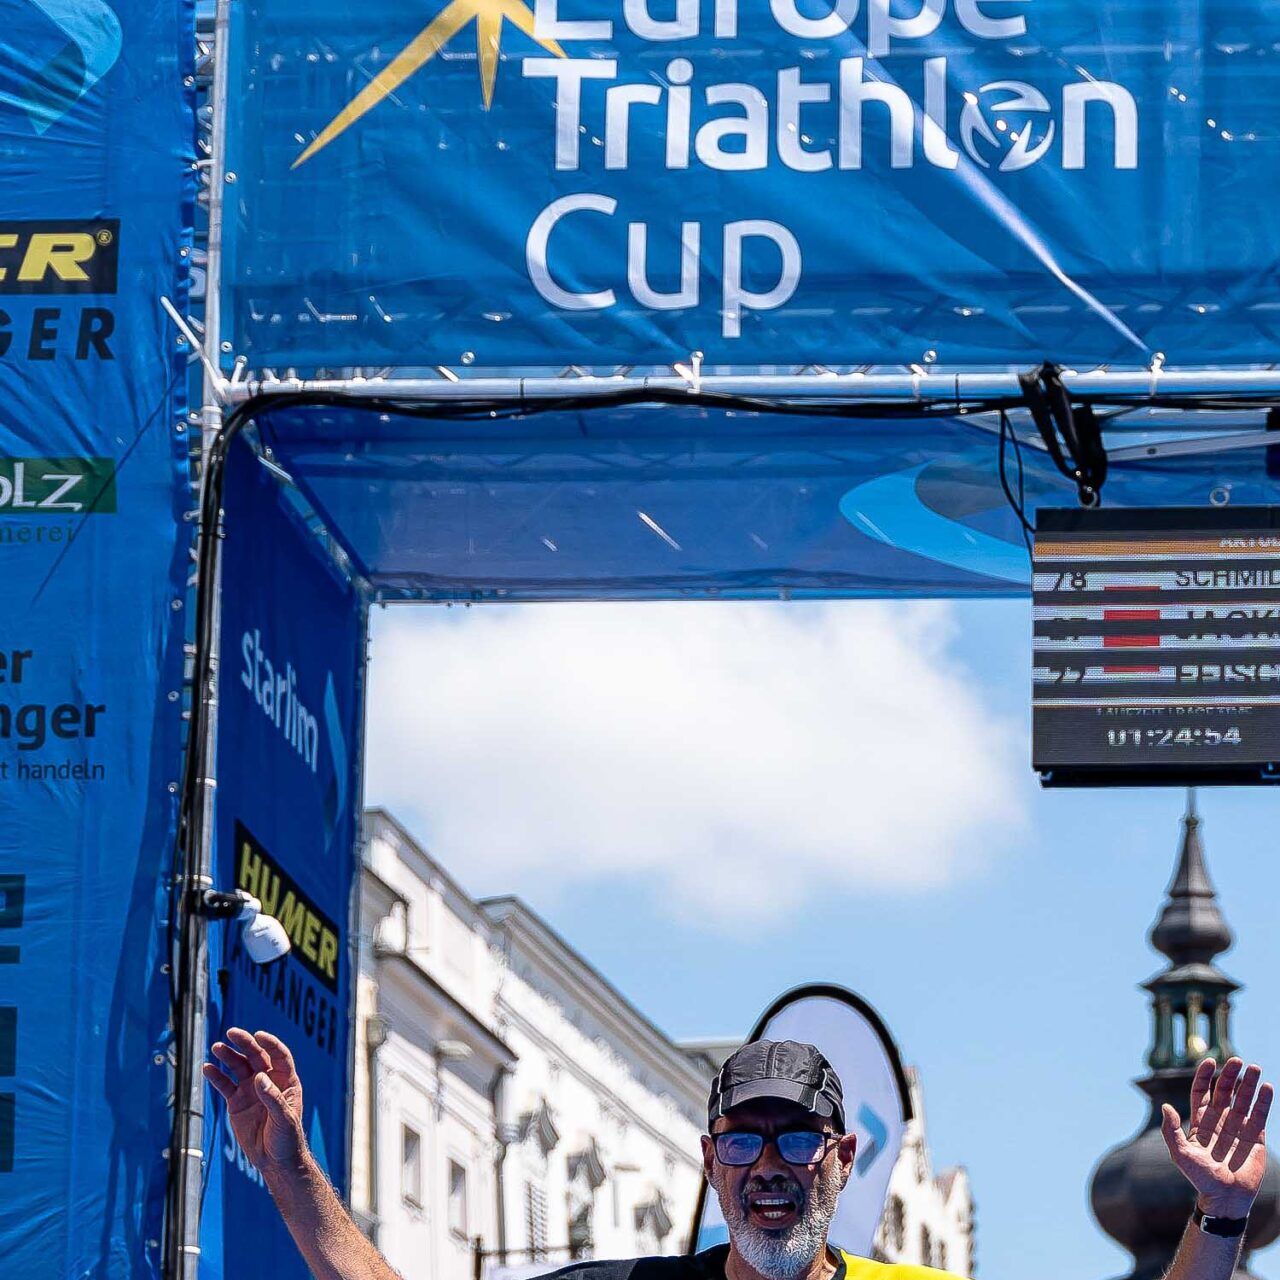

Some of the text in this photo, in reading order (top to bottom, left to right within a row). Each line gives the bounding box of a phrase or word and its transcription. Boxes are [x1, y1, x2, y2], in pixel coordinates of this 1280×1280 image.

[521, 57, 1139, 172] Triathlon
[525, 192, 802, 338] Cup
[17, 758, 105, 780] handeln
[240, 628, 319, 773] starlim
[238, 841, 339, 980] HUMER
